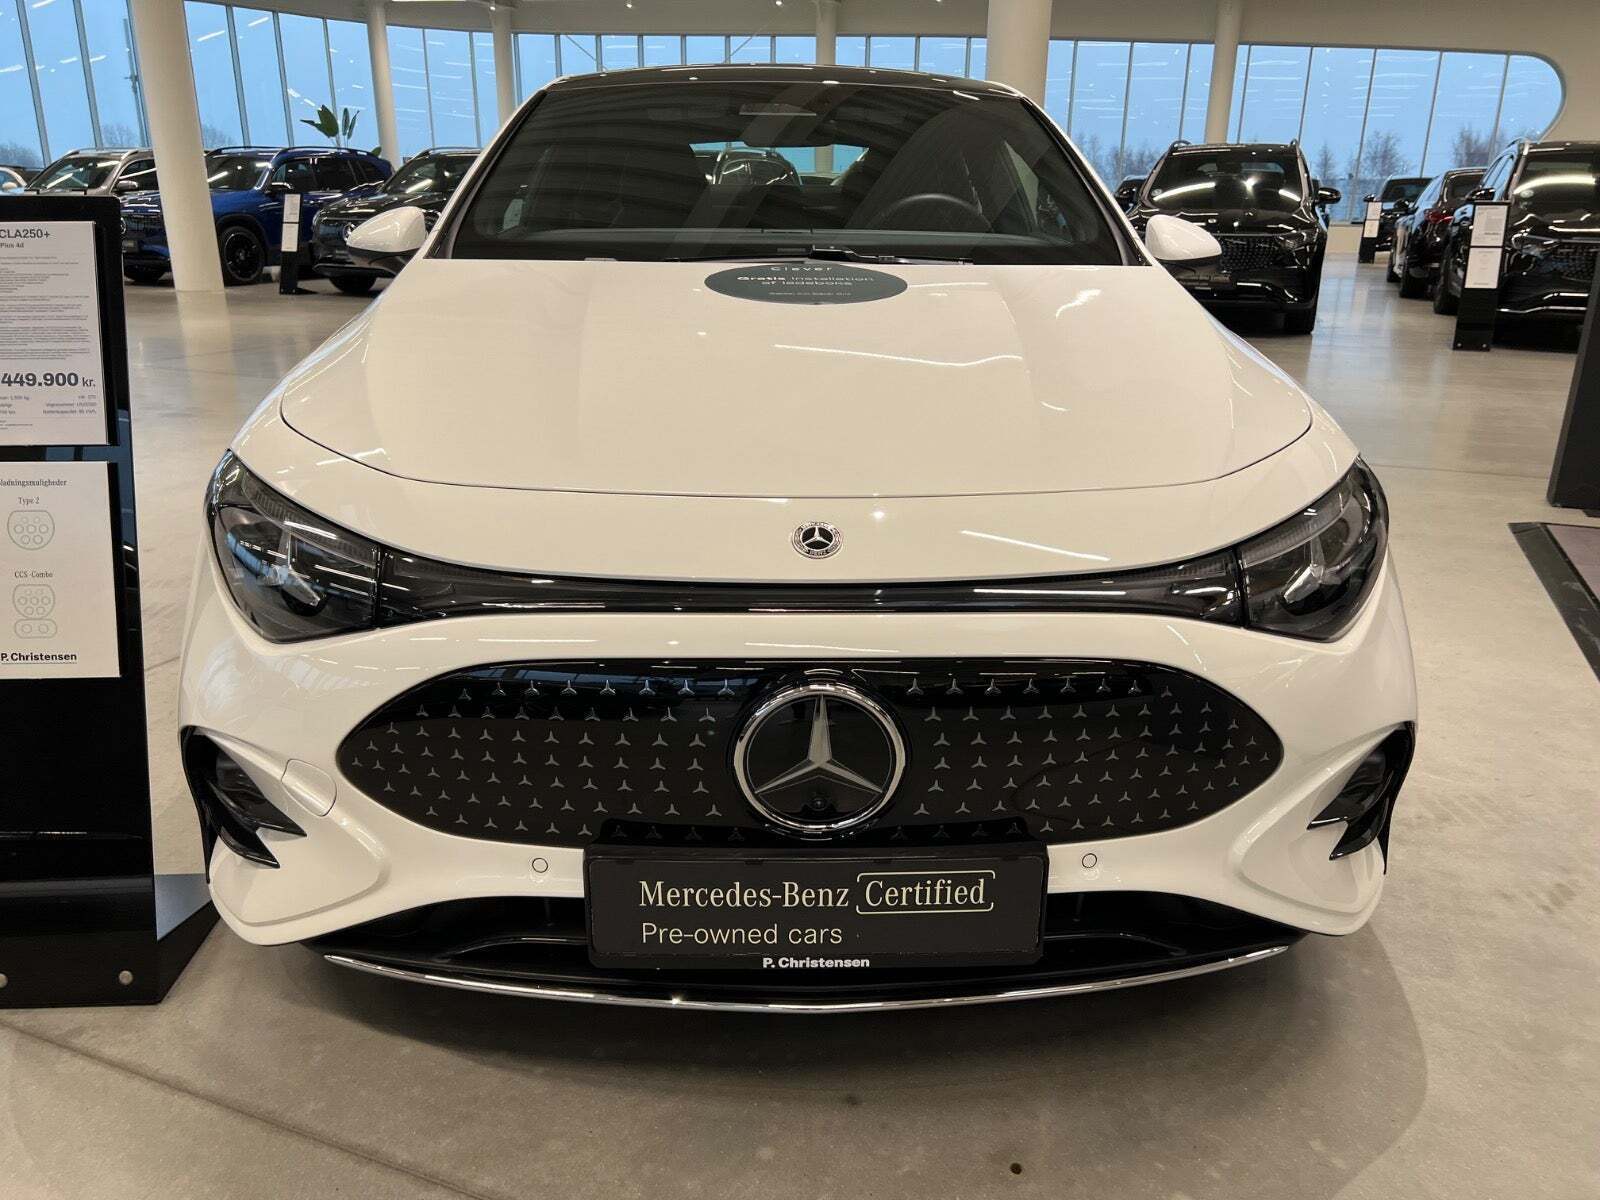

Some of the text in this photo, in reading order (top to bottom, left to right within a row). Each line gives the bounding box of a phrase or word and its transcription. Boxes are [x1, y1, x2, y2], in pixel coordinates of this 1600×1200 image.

[0, 228, 51, 239] CLA250+
[1, 372, 96, 388] 449.900 kr.
[0, 478, 67, 488] ladningsmuligheder
[18, 496, 40, 505] Type 2
[1, 652, 77, 661] P. Christensen
[639, 878, 985, 908] Mercedes-Benz Certified
[642, 921, 843, 945] Pre-owned cars
[762, 956, 871, 969] P. Christensen
